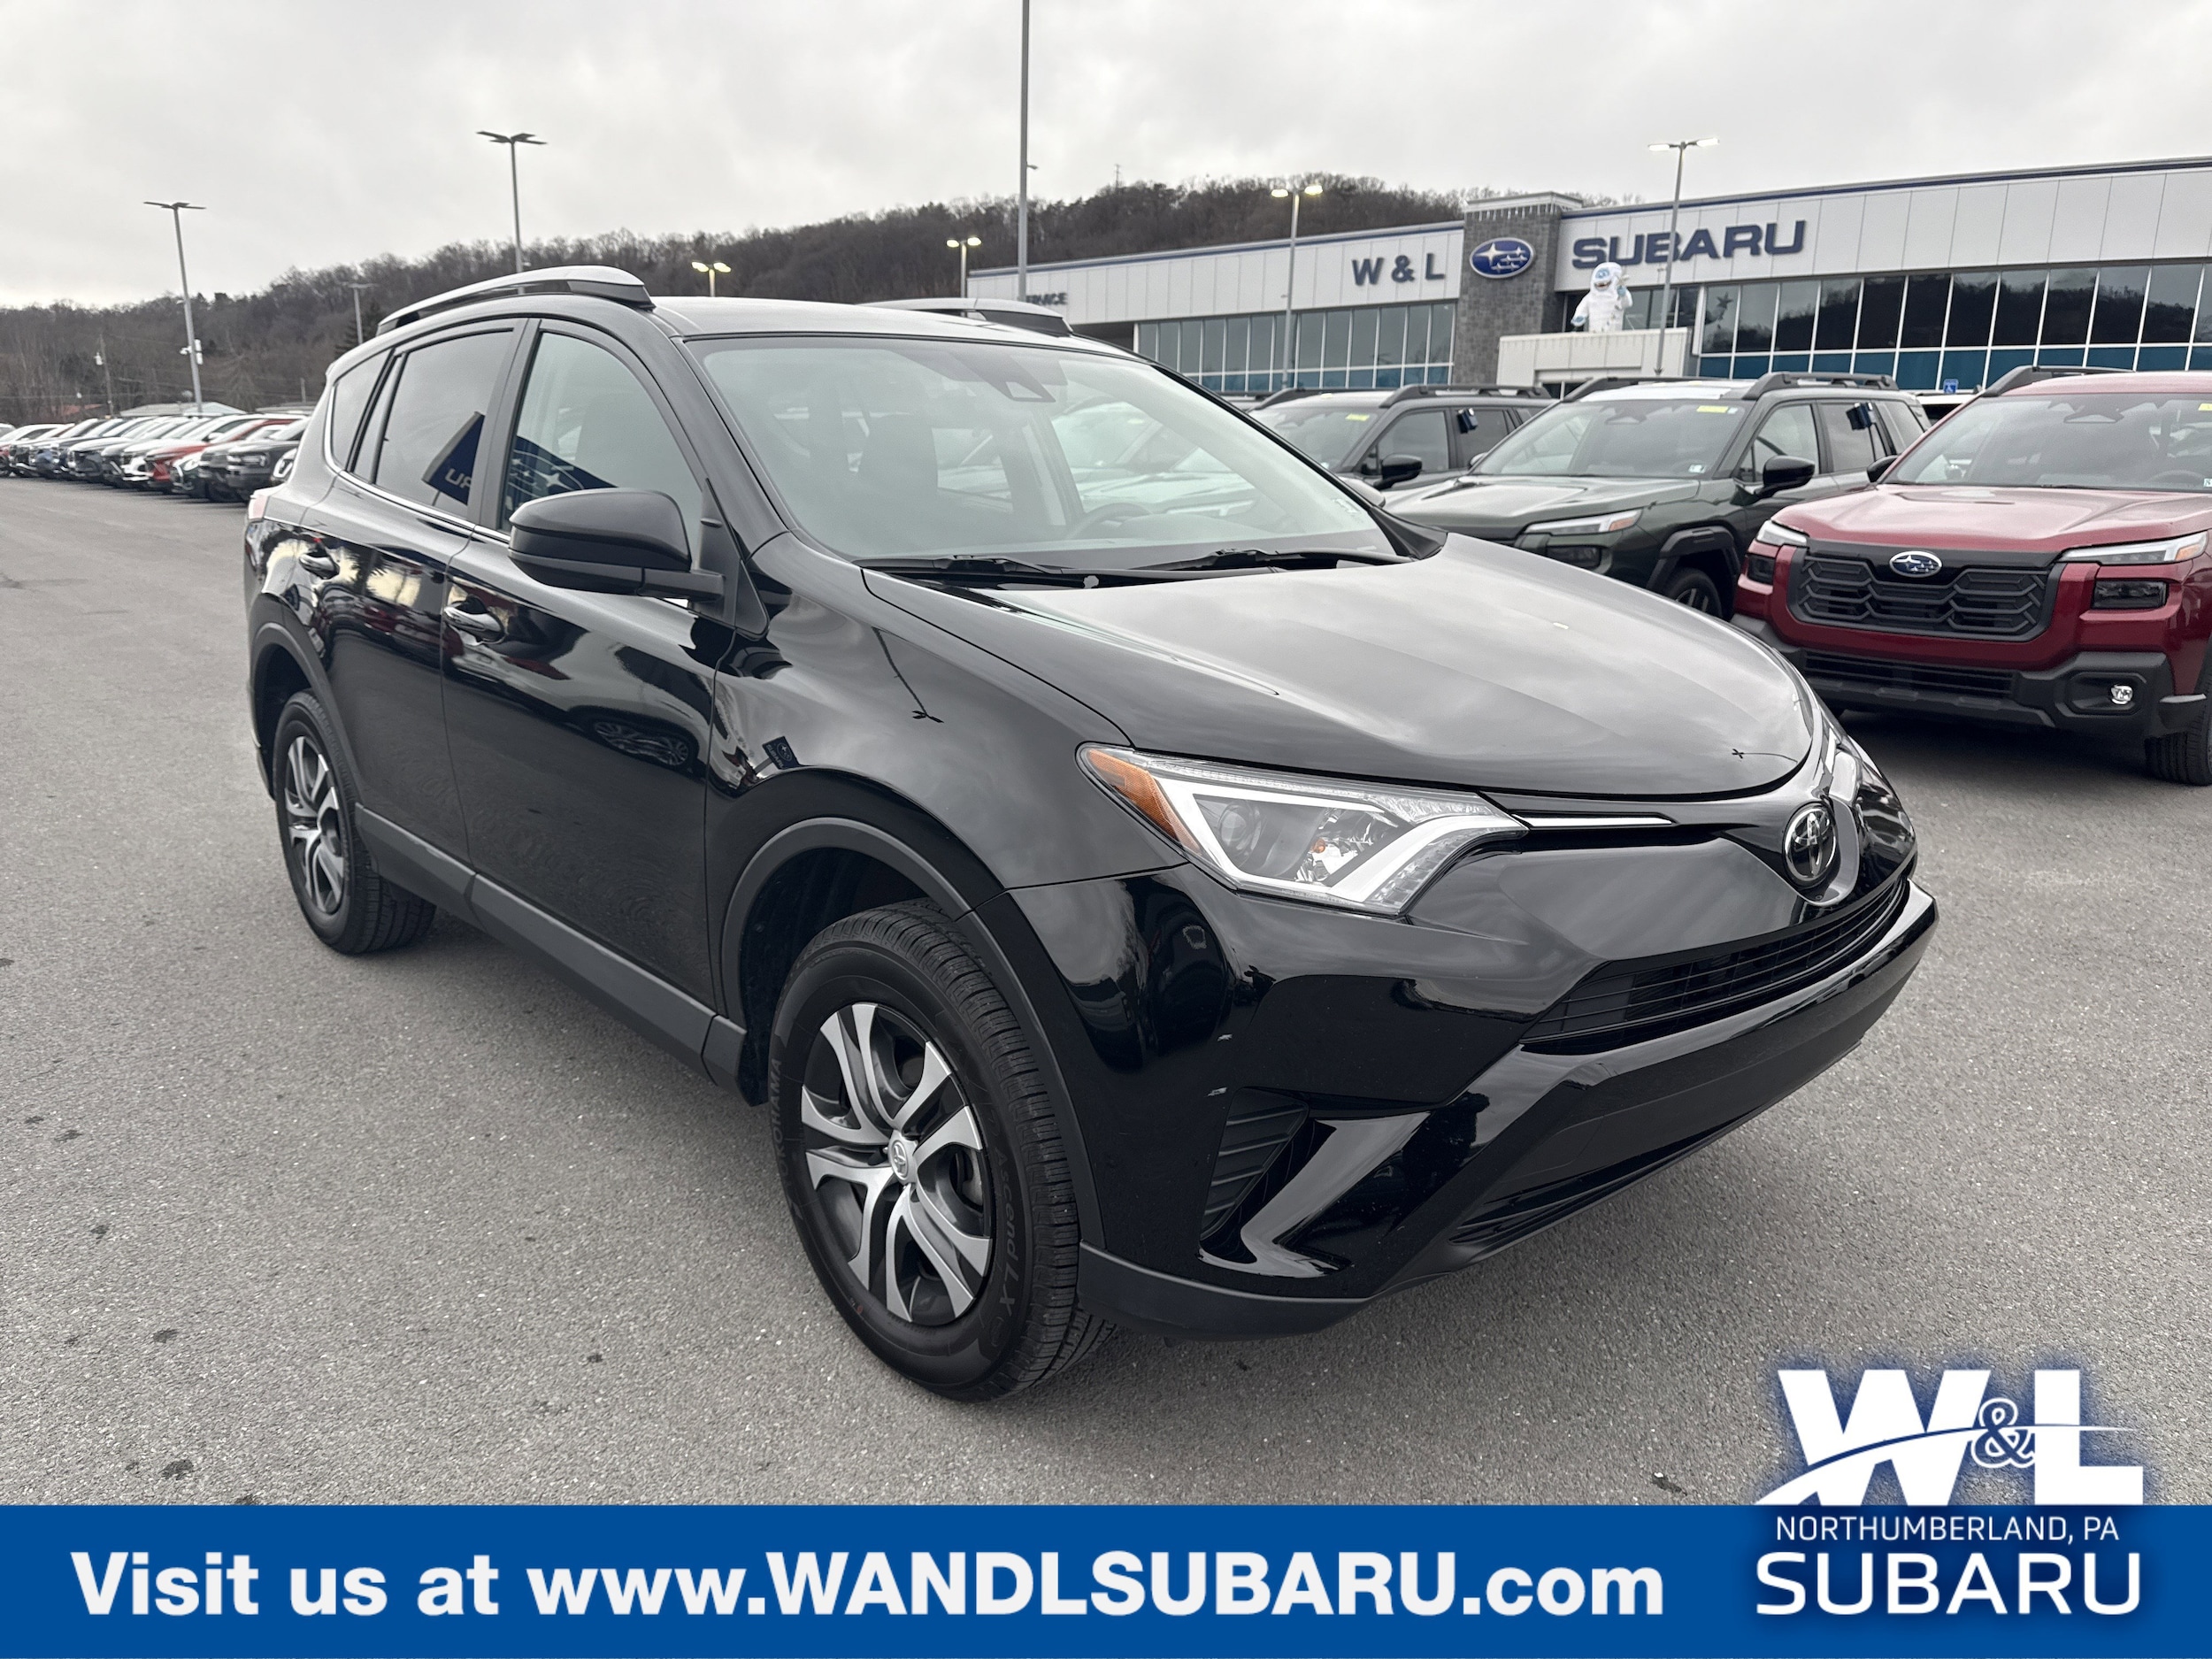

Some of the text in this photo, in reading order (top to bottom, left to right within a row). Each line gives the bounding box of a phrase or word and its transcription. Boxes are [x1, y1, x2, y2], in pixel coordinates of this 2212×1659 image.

[1572, 219, 1806, 269] SUBARU
[1352, 253, 1446, 286] W & L
